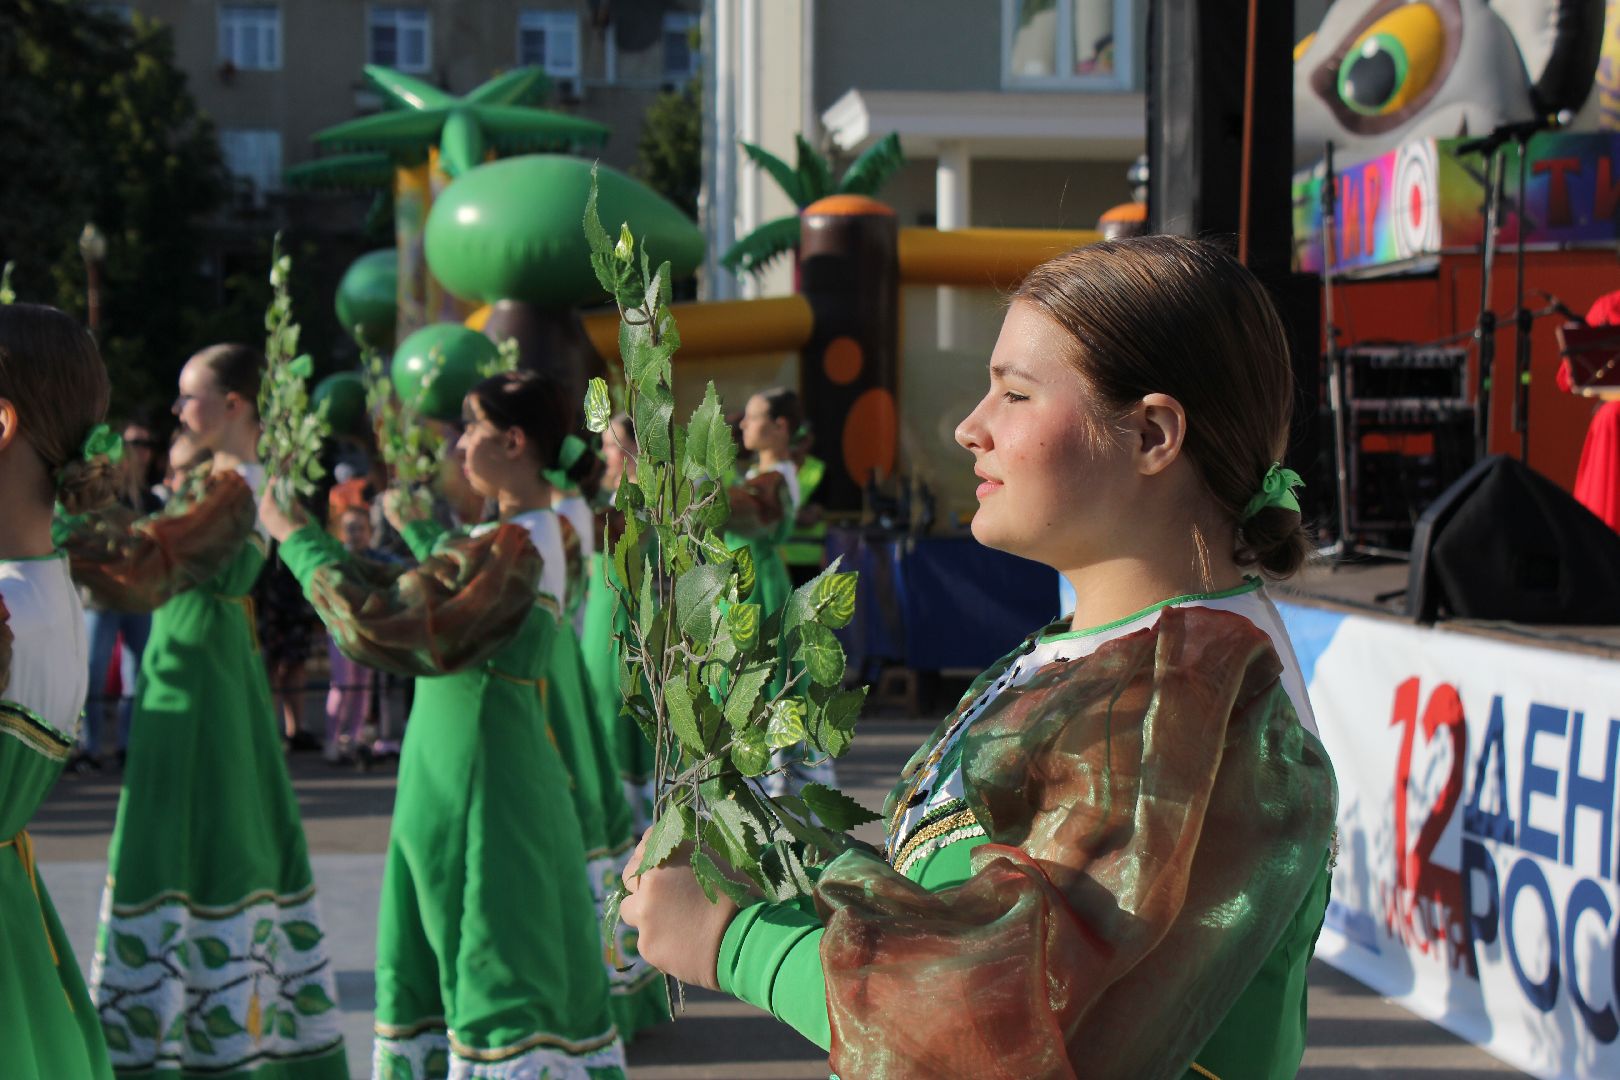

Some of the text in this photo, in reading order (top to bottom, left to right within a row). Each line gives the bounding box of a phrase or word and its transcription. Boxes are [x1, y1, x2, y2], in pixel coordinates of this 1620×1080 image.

[1389, 674, 1464, 905] 12
[1463, 695, 1620, 884] ДЕН
[1461, 837, 1620, 1044] РОС
